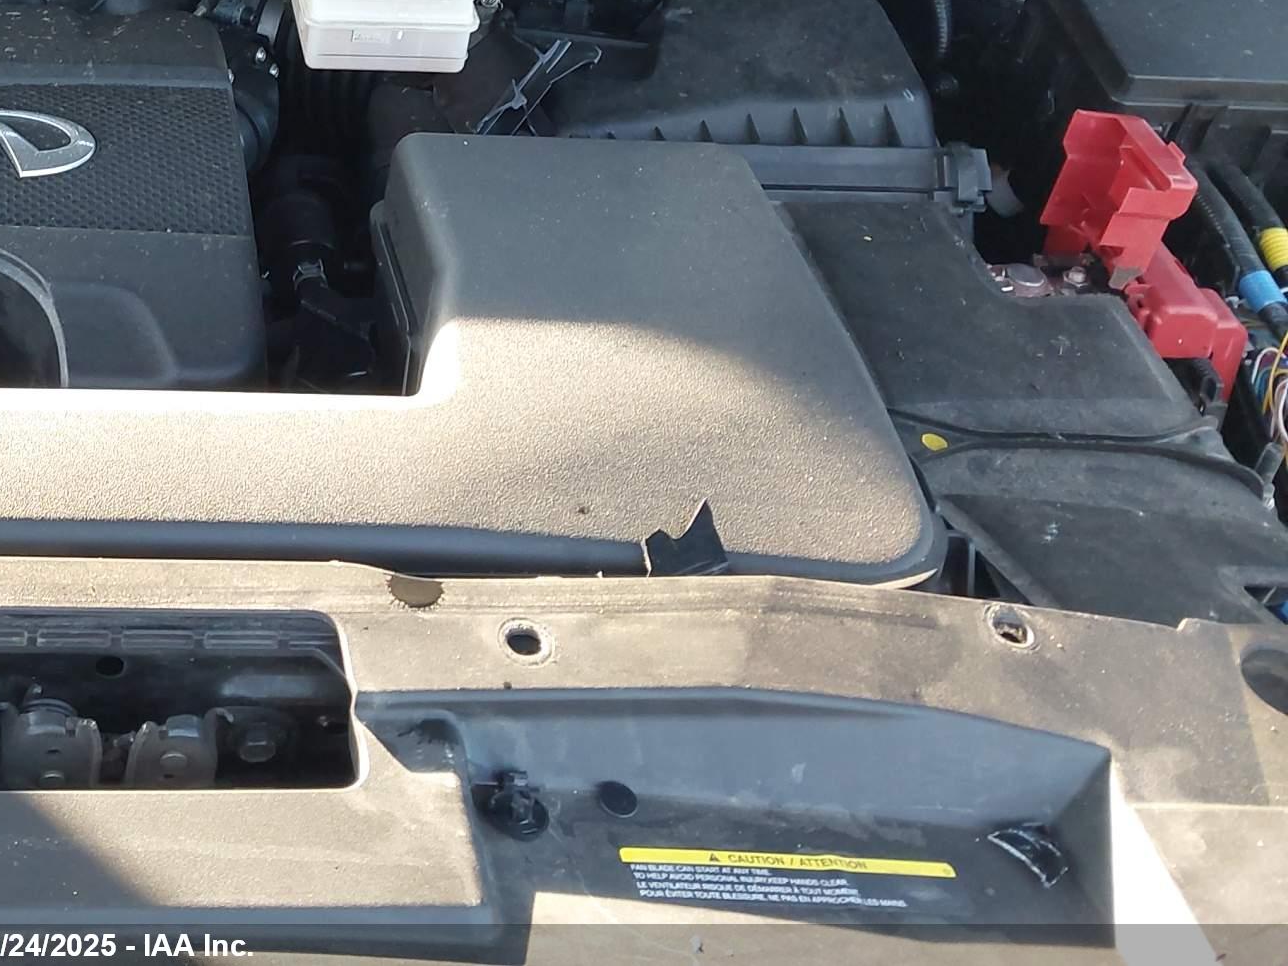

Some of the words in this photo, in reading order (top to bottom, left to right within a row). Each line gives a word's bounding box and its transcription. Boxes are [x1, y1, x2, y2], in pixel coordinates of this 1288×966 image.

[727, 854, 785, 866] CAUTION
[799, 856, 867, 869] ATTENTION
[630, 863, 648, 872] FAN
[648, 864, 675, 872] BLADE
[675, 865, 694, 873] CAN
[733, 867, 750, 875] ANY
[750, 868, 772, 876] TIME.
[646, 872, 669, 880] HELP
[669, 873, 694, 881] AVOID
[695, 874, 739, 882] PERSONAL
[790, 878, 819, 886] HANDS
[648, 881, 701, 890] VENTILATEUR
[702, 883, 733, 891] RISQUE
[734, 884, 746, 892] DE
[746, 883, 792, 893] DÉMARRER
[639, 889, 665, 897] POUR
[665, 888, 694, 898] ÉVITER
[695, 891, 722, 899] TOUTE
[813, 896, 863, 905] APPROCHER
[863, 898, 880, 906] LES
